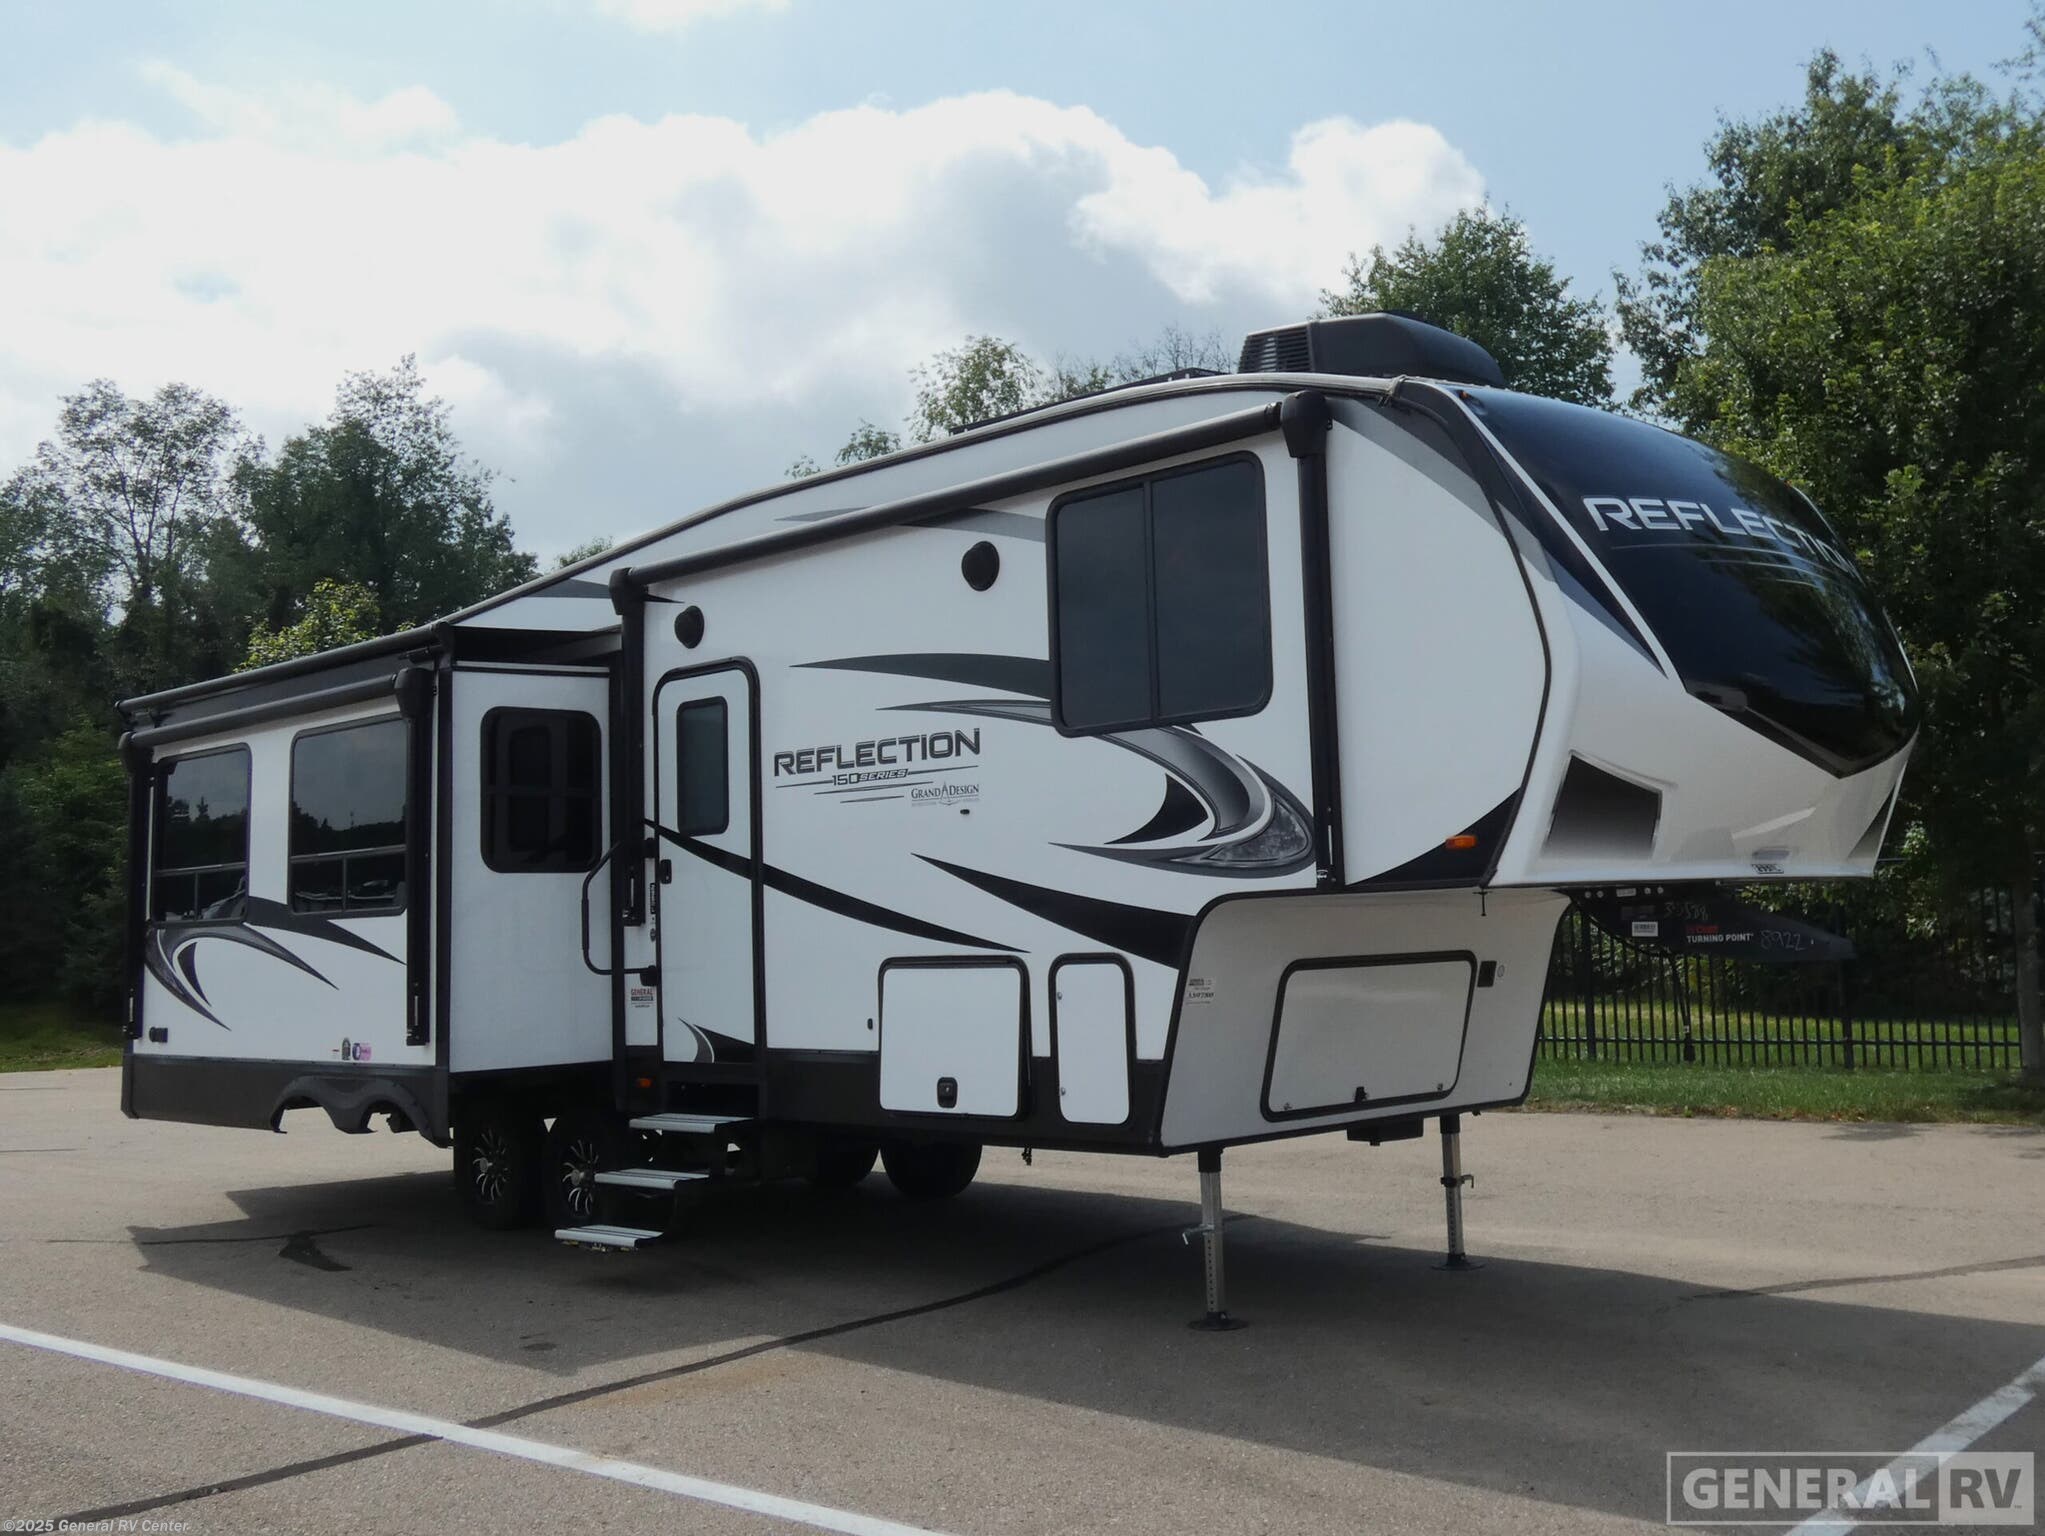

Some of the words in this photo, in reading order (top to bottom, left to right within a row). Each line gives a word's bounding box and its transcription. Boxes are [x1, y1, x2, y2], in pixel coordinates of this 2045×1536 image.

[774, 728, 980, 777] REFLECTION
[858, 769, 908, 783] SERIES
[911, 788, 940, 799] GRAND
[949, 784, 979, 796] DESIGN
[1687, 934, 1723, 943] TURNING
